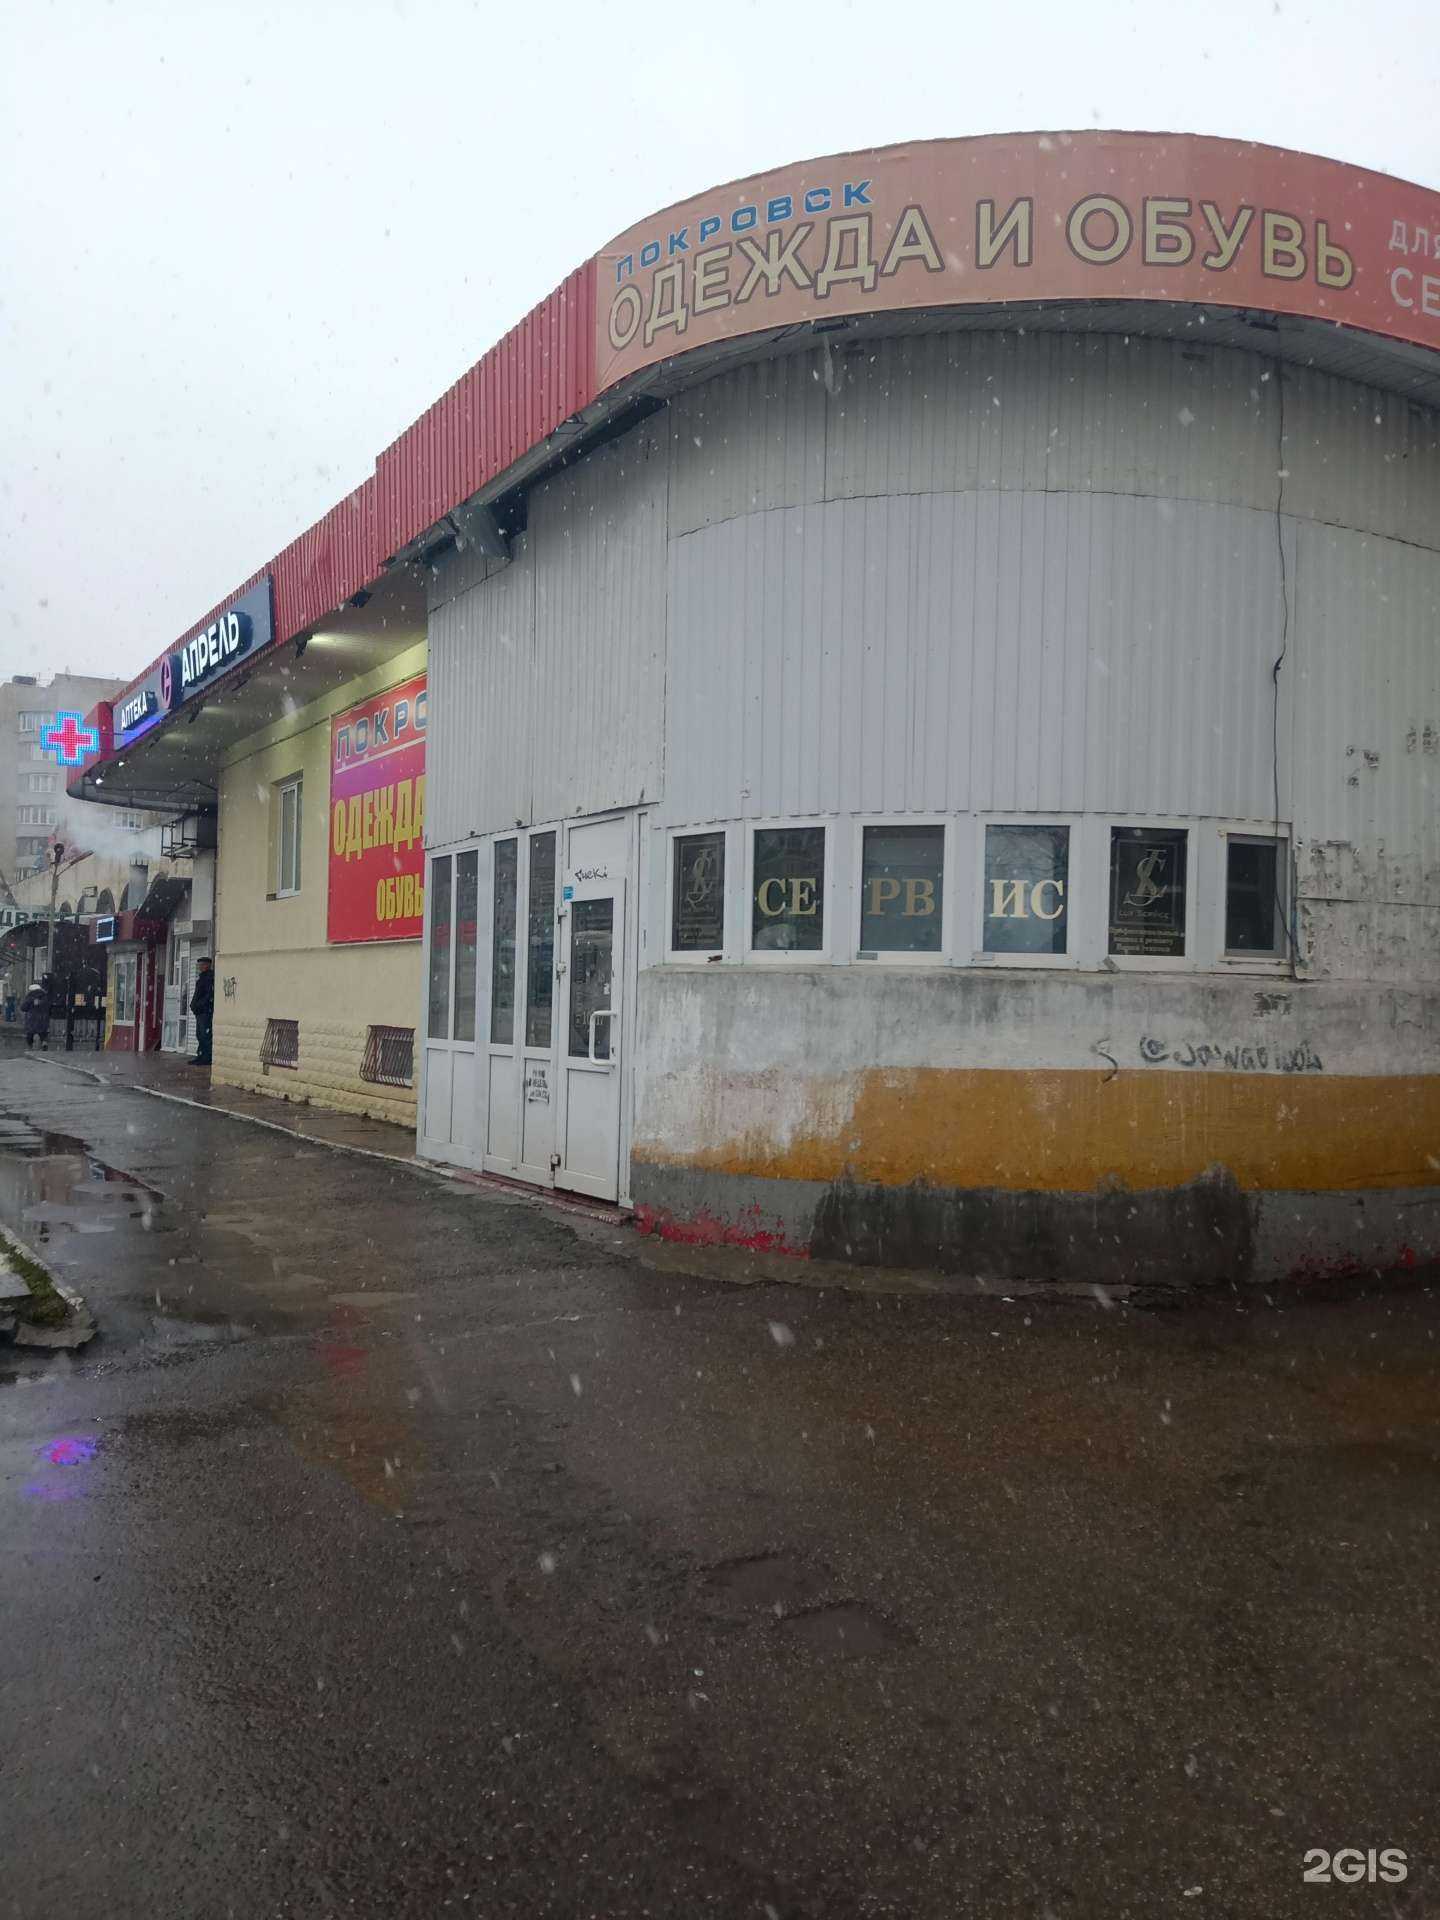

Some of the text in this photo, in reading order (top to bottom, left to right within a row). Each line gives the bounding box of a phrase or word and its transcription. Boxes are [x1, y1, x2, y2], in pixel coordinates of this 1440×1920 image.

[608, 194, 1354, 351] ОДЕЖДА И ОБУВЬ
[614, 178, 874, 284] ПОКРОВСК
[120, 611, 240, 731] АПТЕКА АПРЕЛЬ
[334, 774, 426, 862] ОДЕЖДА
[376, 873, 424, 922] ОБУВЬ
[757, 877, 1065, 920] СЕ РВ ИС
